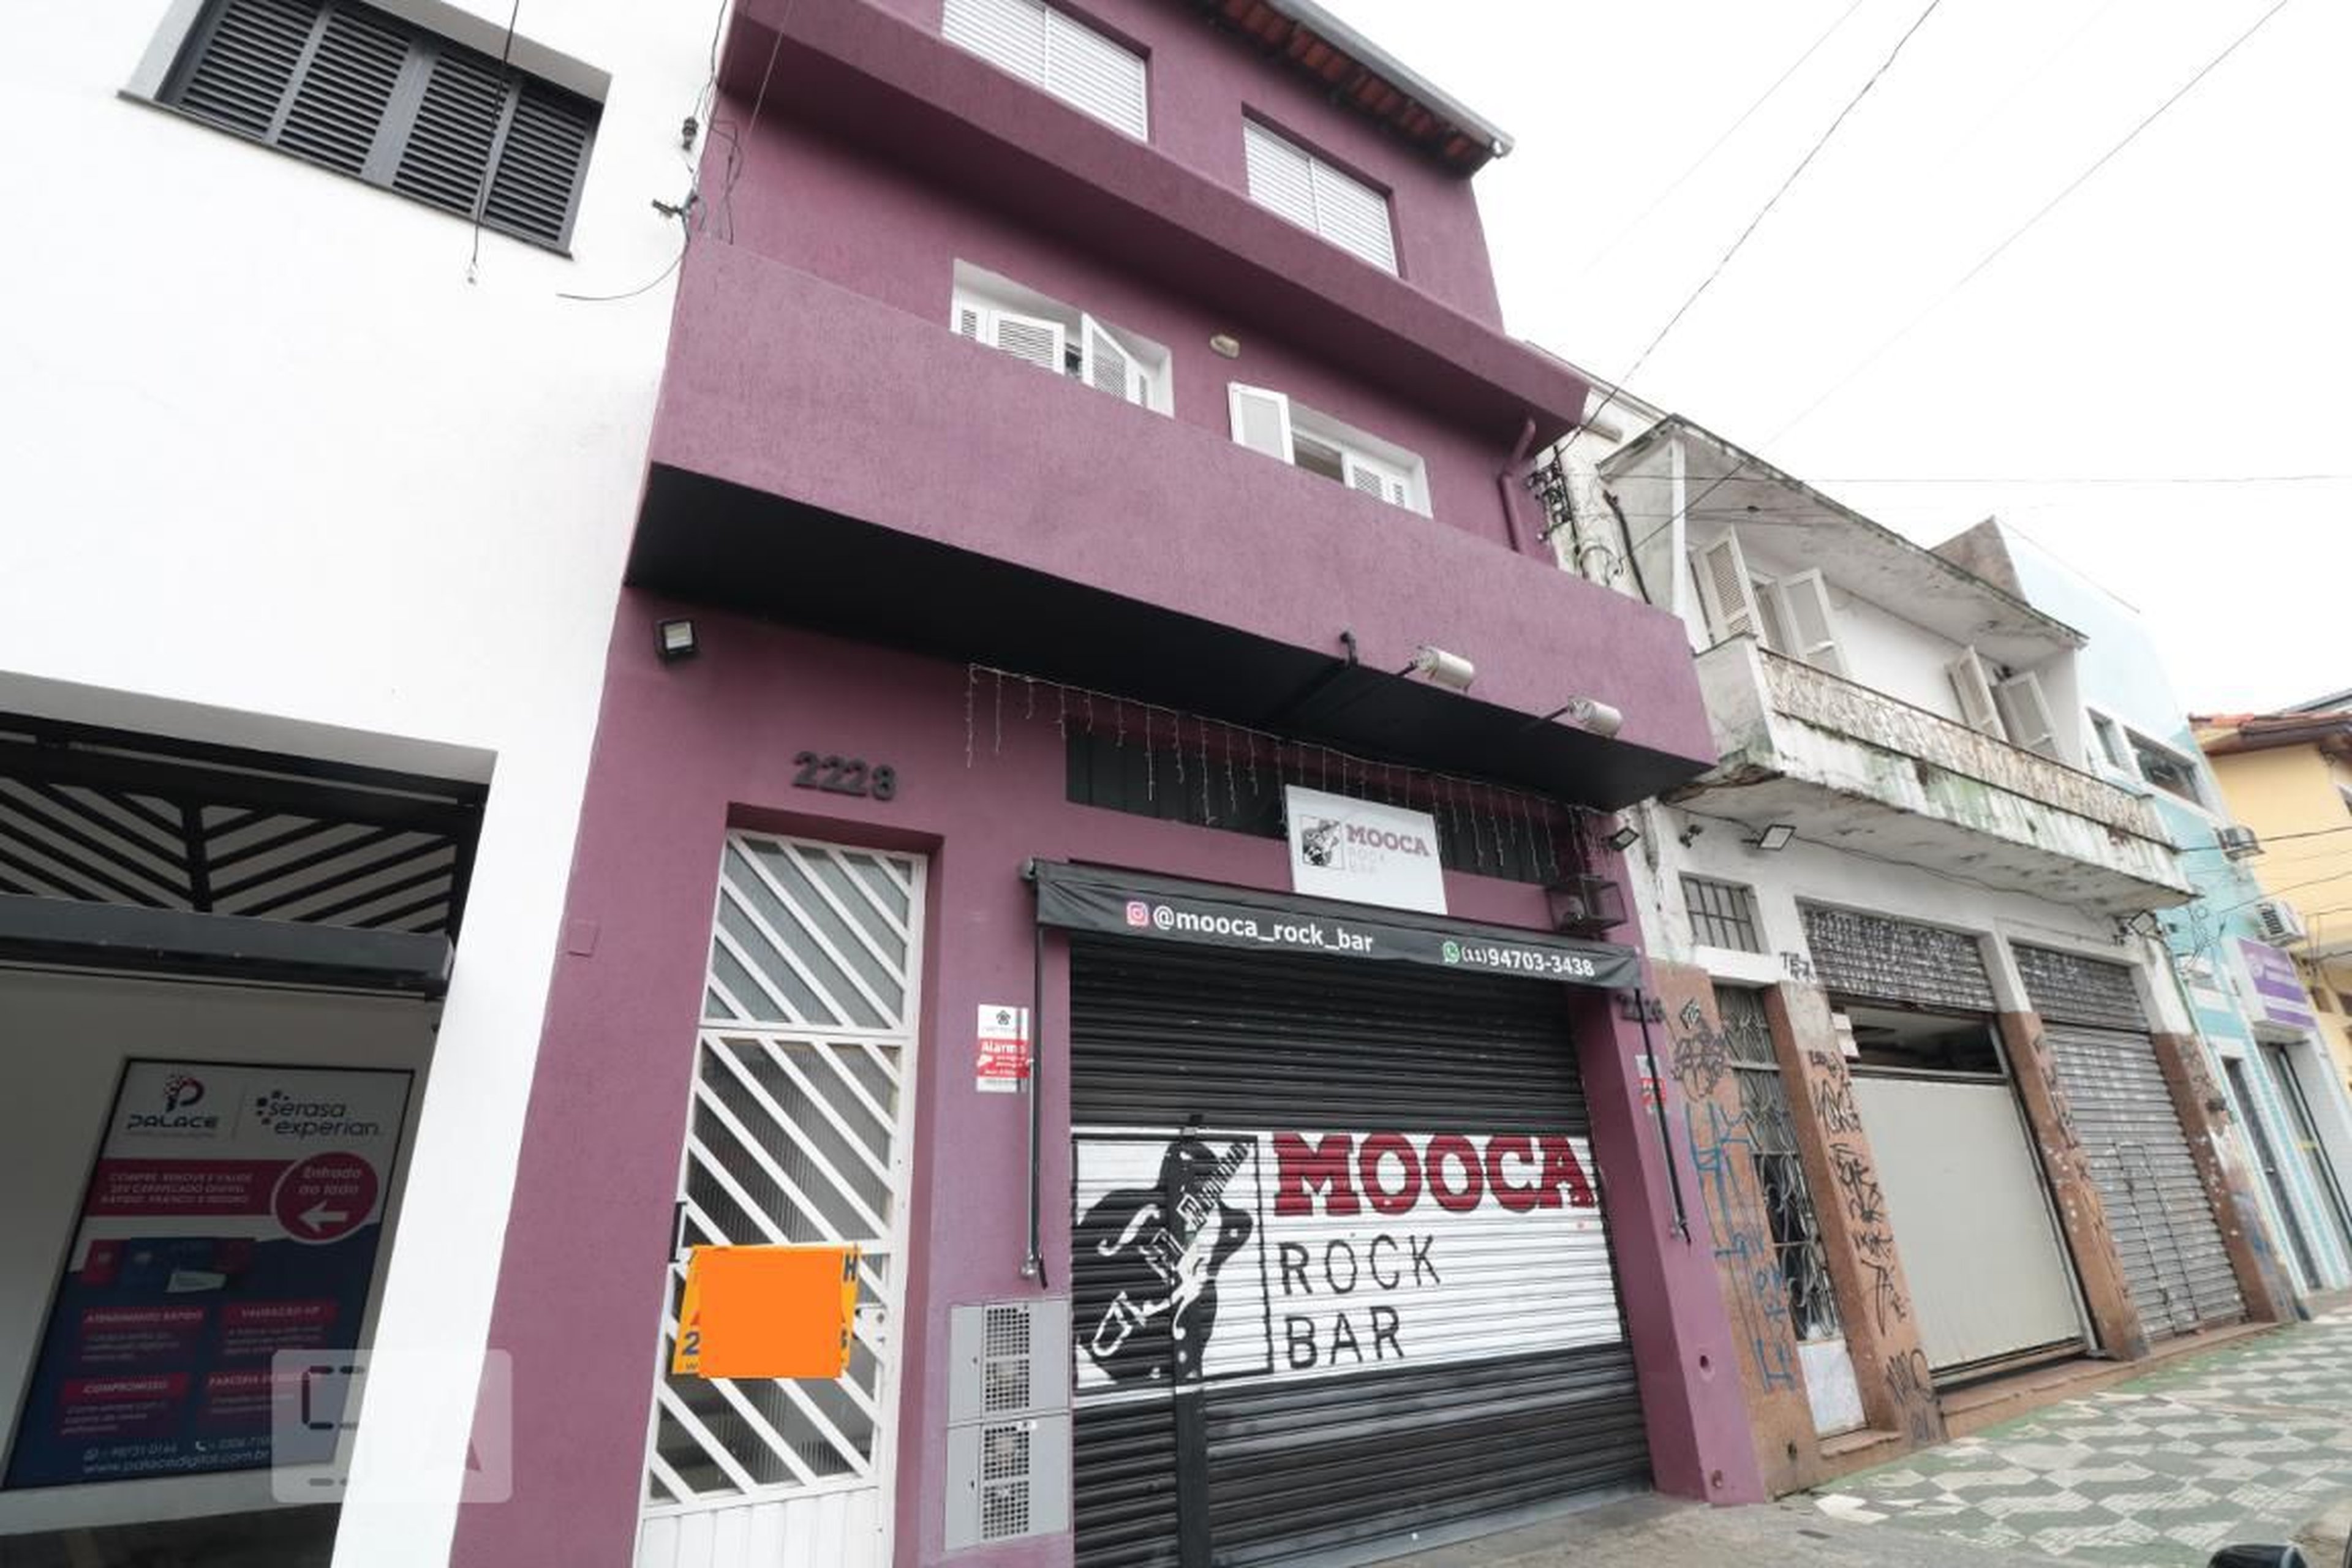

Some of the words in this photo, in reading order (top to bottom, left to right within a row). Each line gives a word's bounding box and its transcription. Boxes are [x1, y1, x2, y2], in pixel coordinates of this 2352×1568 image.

[792, 750, 897, 802] 2228
[1345, 823, 1431, 857] MOOCA
[1153, 905, 1374, 952] @mooca_rock_bar
[1461, 946, 1596, 977] (11)94703-3438
[127, 1114, 220, 1131] PALACE
[270, 1101, 345, 1118] serasa
[274, 1119, 379, 1139] experian
[298, 1184, 320, 1196] ao
[1272, 1131, 1597, 1216] MOOCA
[1278, 1234, 1441, 1296] ROCK
[1284, 1304, 1404, 1370] BAR
